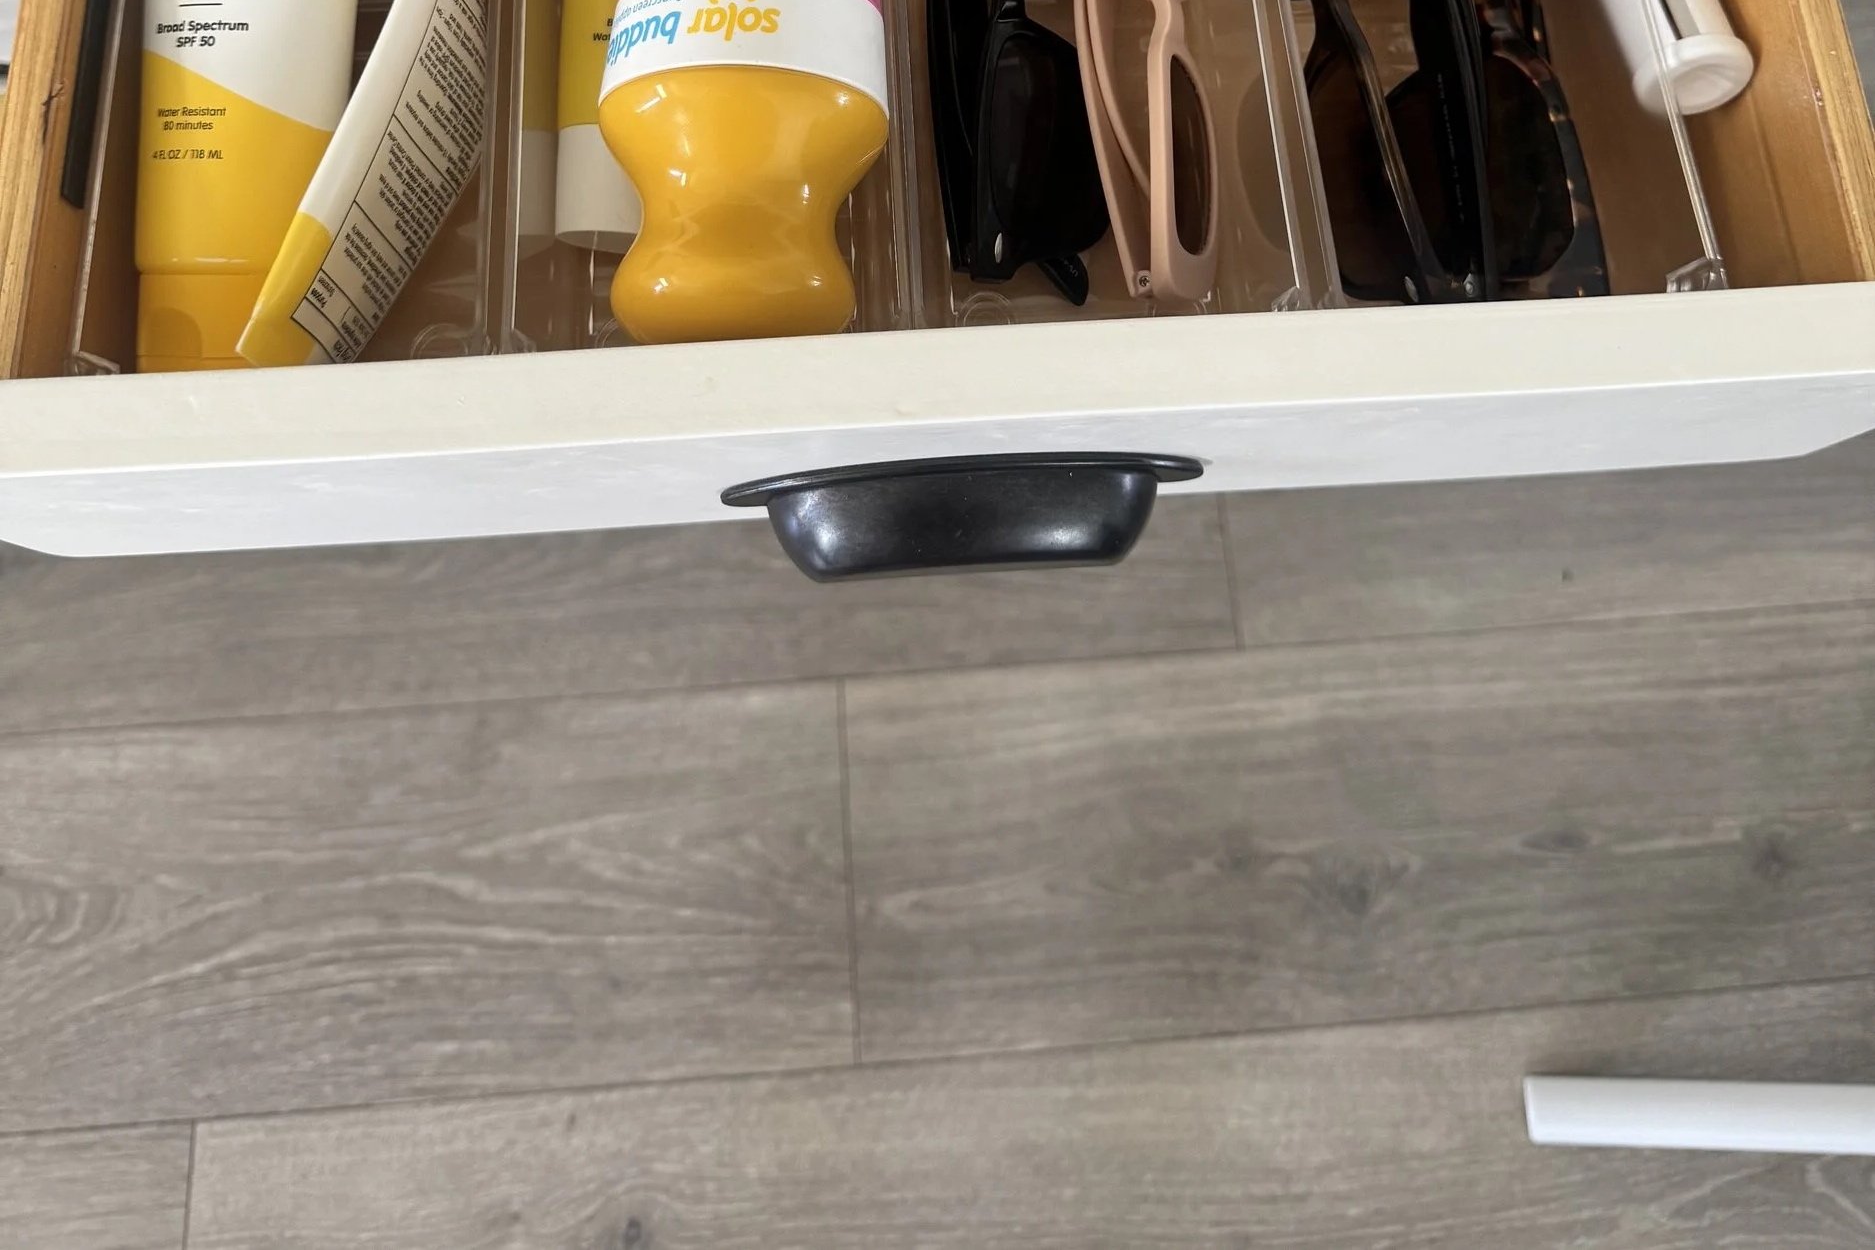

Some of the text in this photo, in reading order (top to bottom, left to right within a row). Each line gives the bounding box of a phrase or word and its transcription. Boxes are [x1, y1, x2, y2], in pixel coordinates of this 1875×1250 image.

[156, 19, 249, 34] Broad Spectrum
[687, 2, 781, 41] solar
[176, 35, 216, 48] SPF 50
[158, 106, 226, 117] Water Resistant
[163, 120, 214, 131] 80 minutes
[168, 149, 181, 160] OZ
[190, 149, 206, 160] 118
[208, 149, 224, 160] ML
